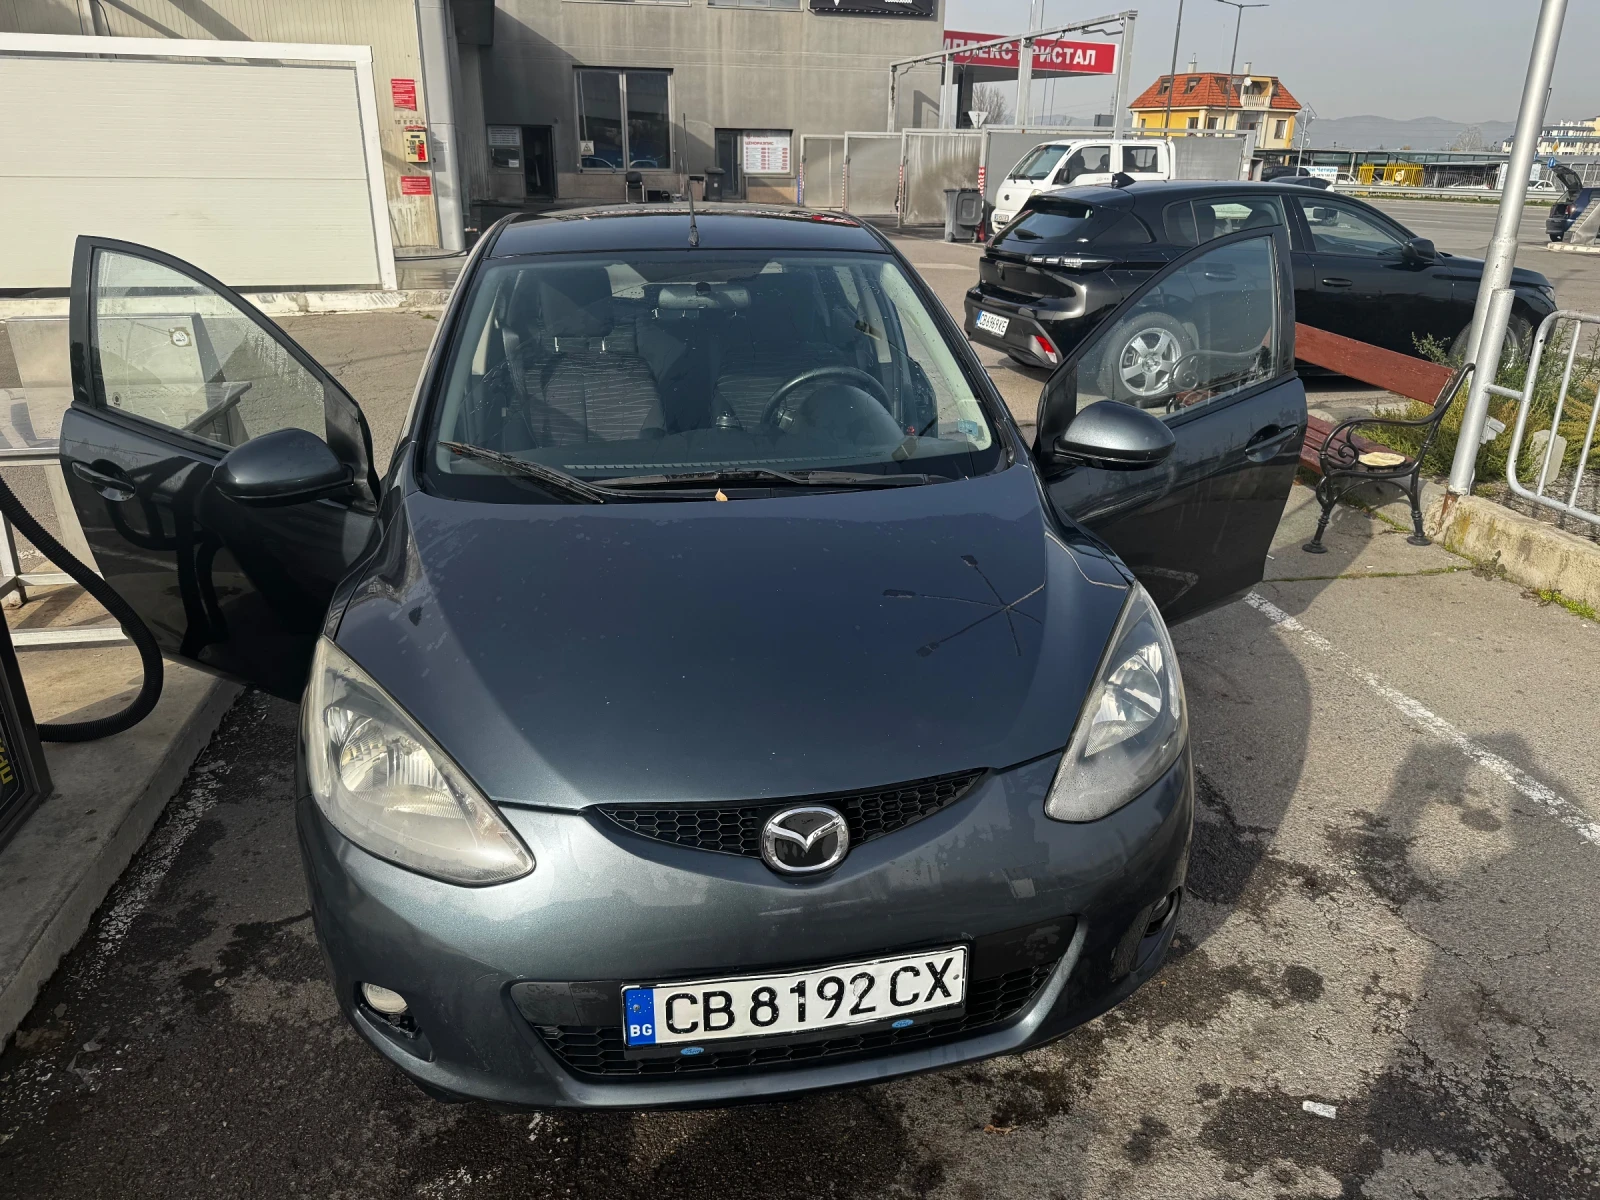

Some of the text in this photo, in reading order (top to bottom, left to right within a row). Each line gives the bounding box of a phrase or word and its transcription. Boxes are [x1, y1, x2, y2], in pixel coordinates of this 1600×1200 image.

[1018, 43, 1096, 66] РИСТАЛ
[665, 957, 954, 1035] CB 8192 CX
[629, 1023, 653, 1038] BG
